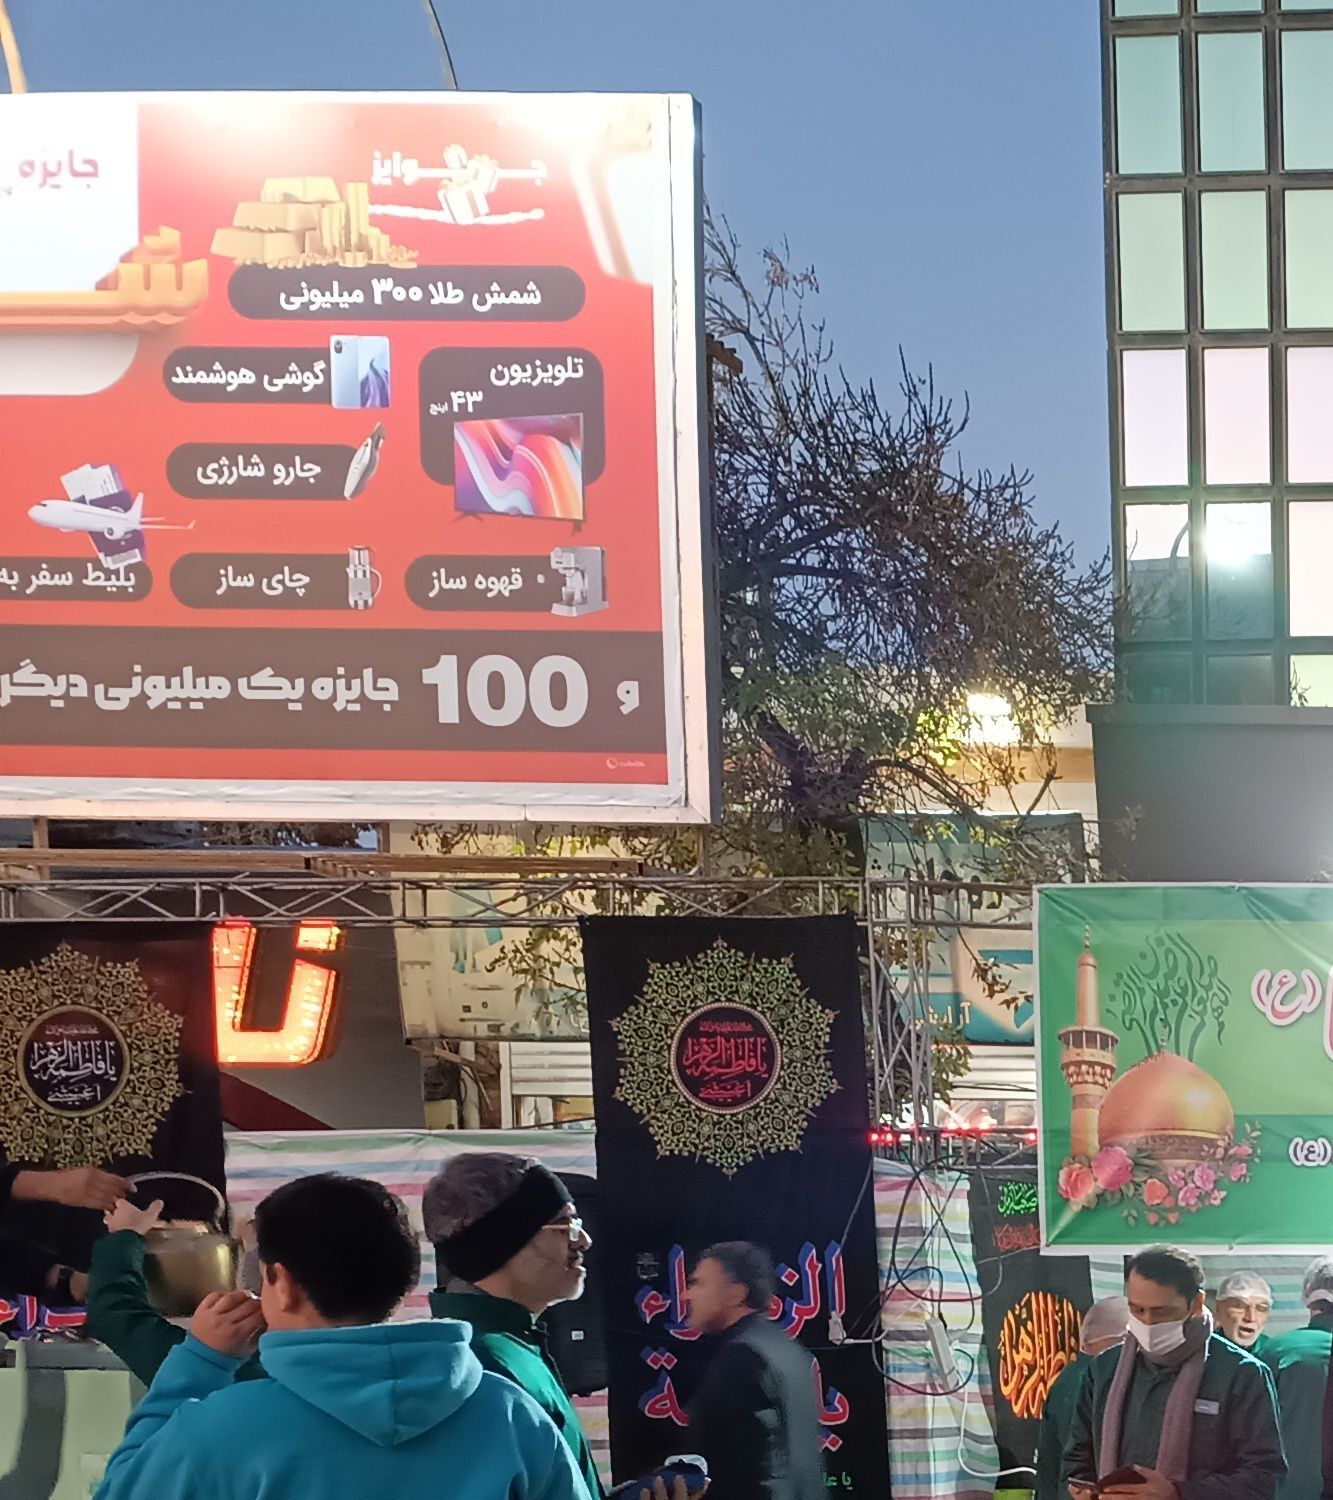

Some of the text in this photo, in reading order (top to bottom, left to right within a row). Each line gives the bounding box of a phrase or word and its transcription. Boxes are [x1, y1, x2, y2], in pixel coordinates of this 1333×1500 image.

[19, 147, 99, 189] جایزه
[279, 278, 541, 312] شمش طلا ۳۰۰ میلیونی
[171, 359, 326, 393] گوشی هوشمند
[489, 355, 584, 387] تلویزیون
[450, 391, 484, 414] ۴۳
[196, 453, 322, 486] جارو شارژی
[25, 564, 74, 592] سفر
[83, 562, 136, 589] بلیط
[216, 565, 311, 599] چای ساز
[429, 567, 523, 597] قهوه ساز
[95, 664, 232, 711] میلیونی
[238, 666, 305, 710] یک
[311, 667, 399, 713] جایزه
[421, 654, 589, 728] 100
[617, 680, 640, 716] و
